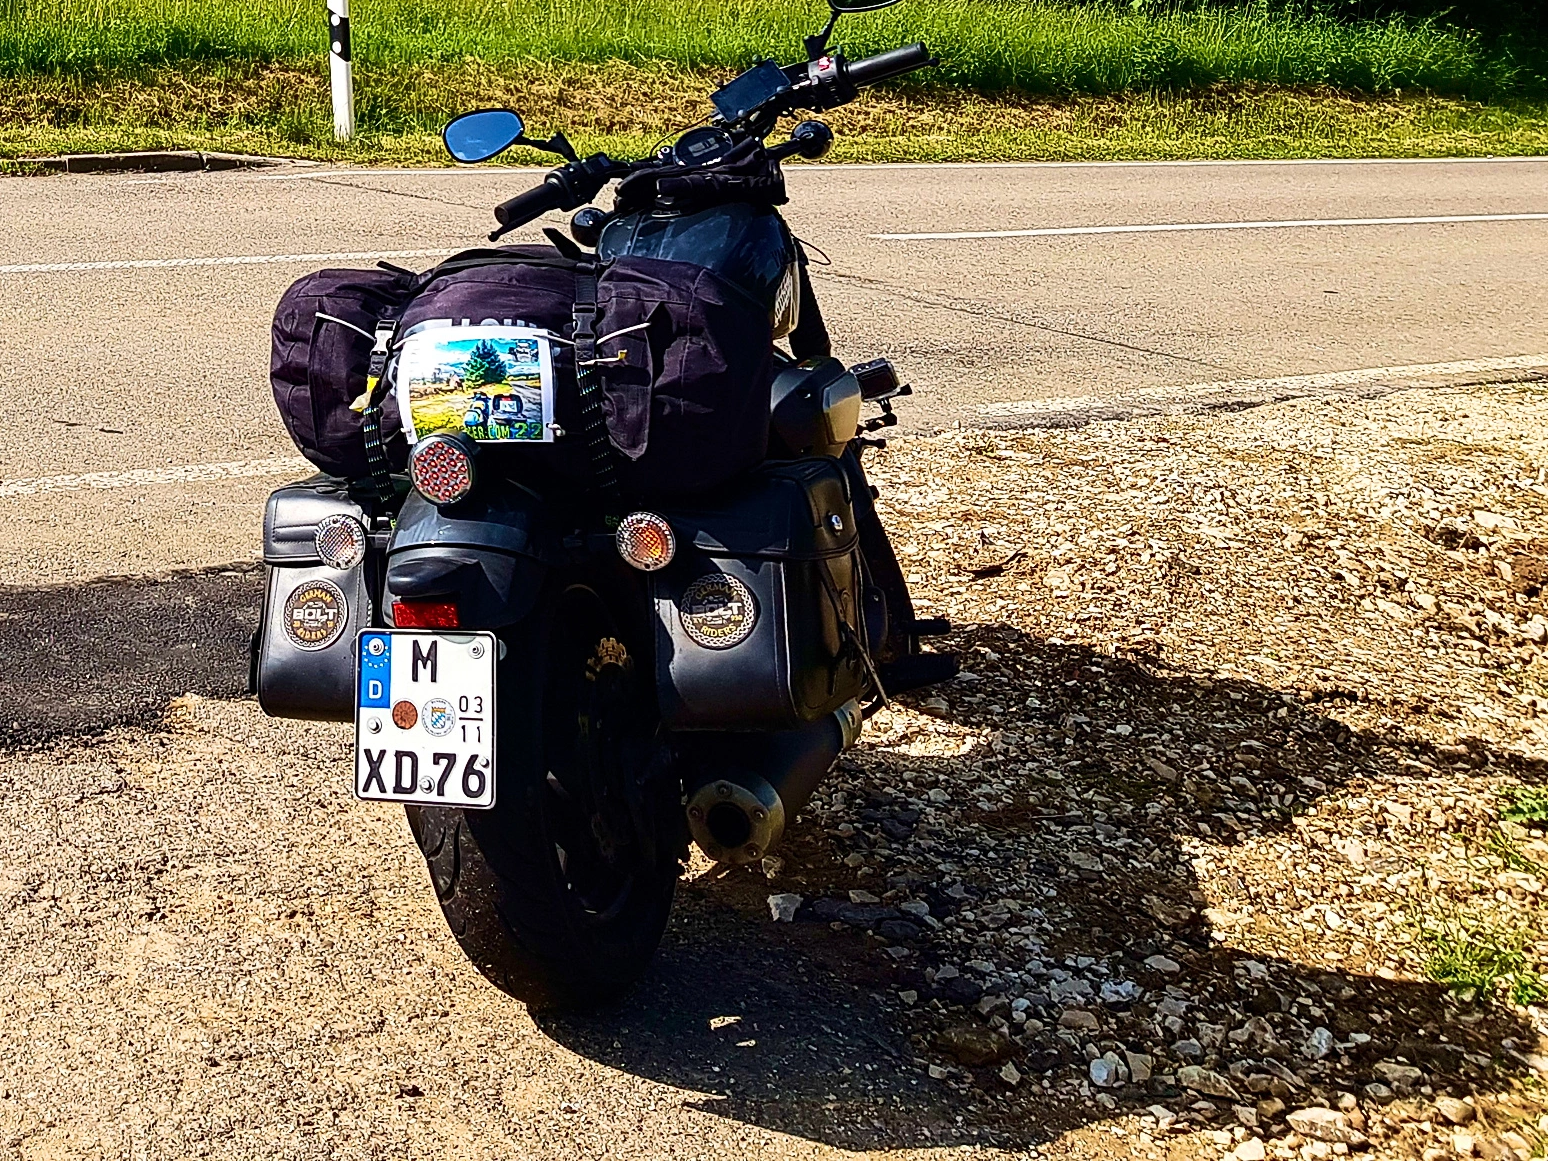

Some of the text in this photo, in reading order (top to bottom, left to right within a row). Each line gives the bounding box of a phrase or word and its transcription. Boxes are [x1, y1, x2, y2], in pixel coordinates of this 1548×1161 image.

[514, 422, 542, 438] 22
[299, 588, 333, 602] GERMAN
[695, 582, 738, 599] GERMAN
[293, 608, 338, 620] BOLT
[296, 627, 327, 640] RIDERS
[700, 622, 737, 637] RIDERS
[411, 639, 438, 683] M
[368, 679, 383, 699] D
[458, 695, 484, 714] 03
[461, 724, 482, 743] 11
